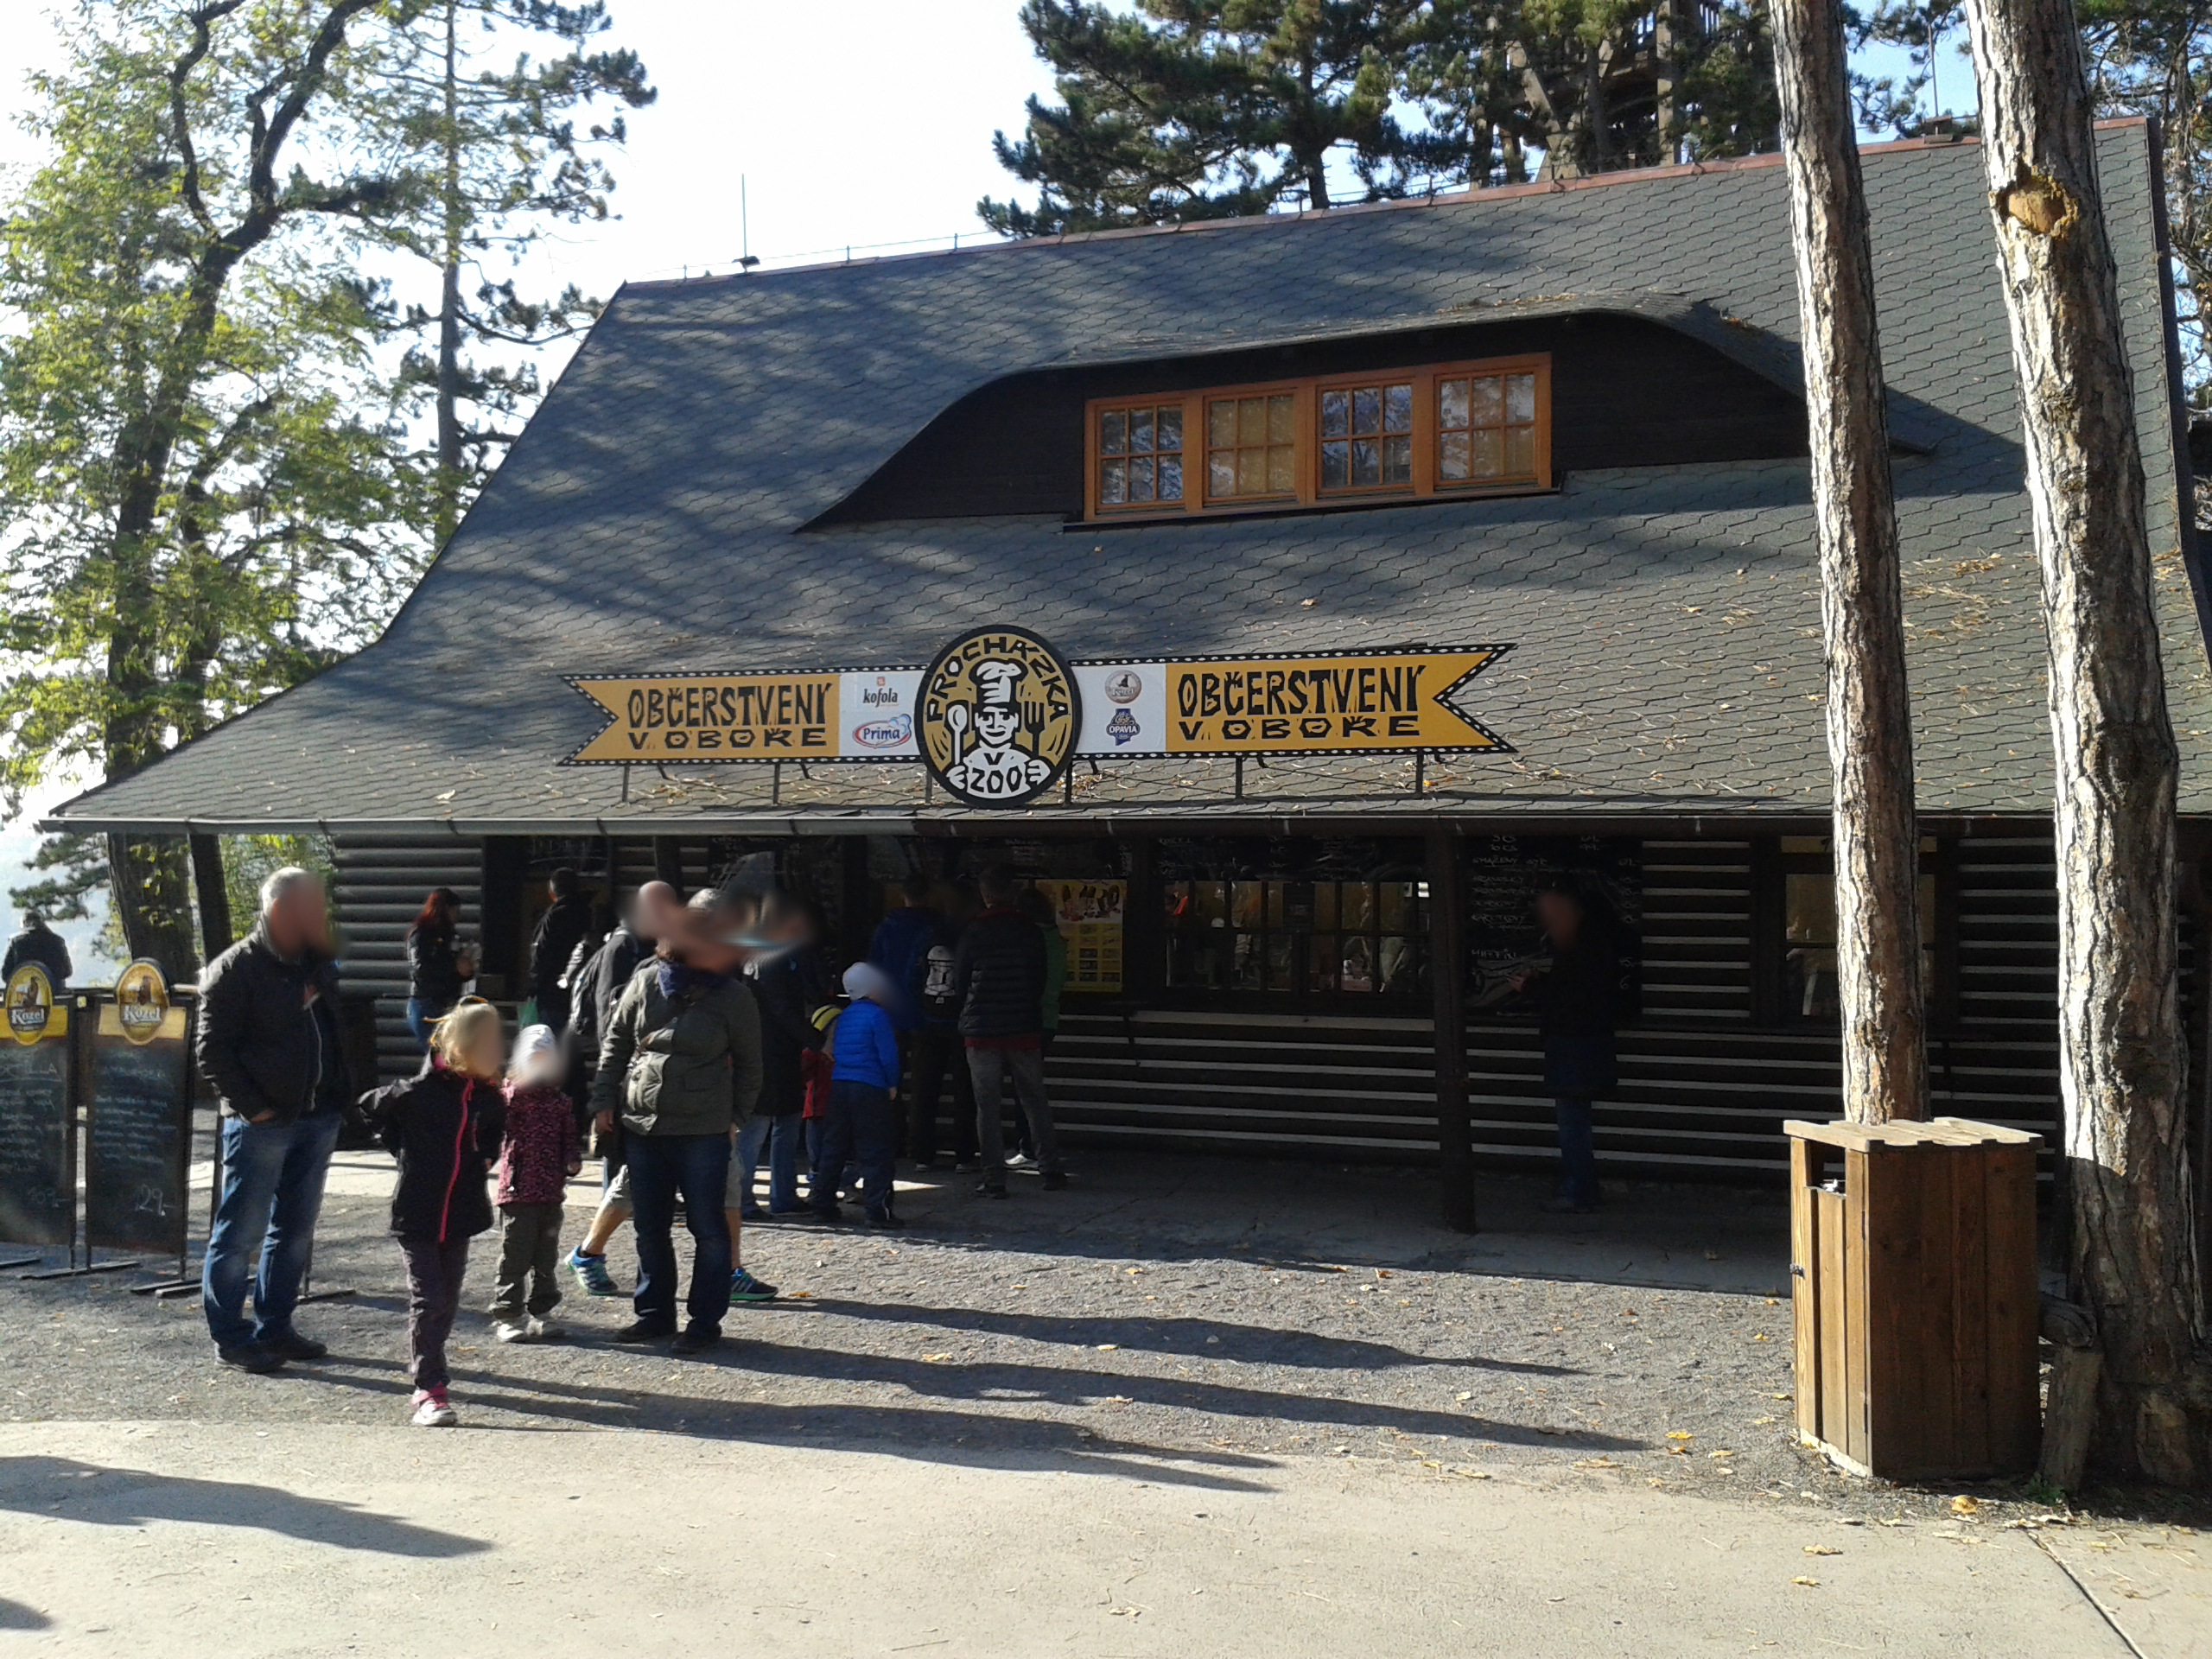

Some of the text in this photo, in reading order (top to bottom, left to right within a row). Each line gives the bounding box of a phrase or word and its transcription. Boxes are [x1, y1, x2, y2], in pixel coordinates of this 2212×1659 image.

[926, 636, 1068, 722] PROCHÁZKA
[862, 688, 899, 708] kofola
[1112, 688, 1134, 696] Kozel
[1178, 664, 1427, 717] OBČERSTVENÍ
[628, 682, 832, 728] OBČERSTVENÍ
[863, 727, 900, 740] Prima
[1109, 725, 1137, 734] OPAVIA
[1179, 715, 1420, 741] V OBOŘE
[628, 728, 827, 750] V OBOŘE
[984, 752, 1005, 766] V
[970, 766, 1022, 793] ZOO
[12, 1008, 45, 1025] Kozel
[123, 1006, 161, 1023] Kozel
